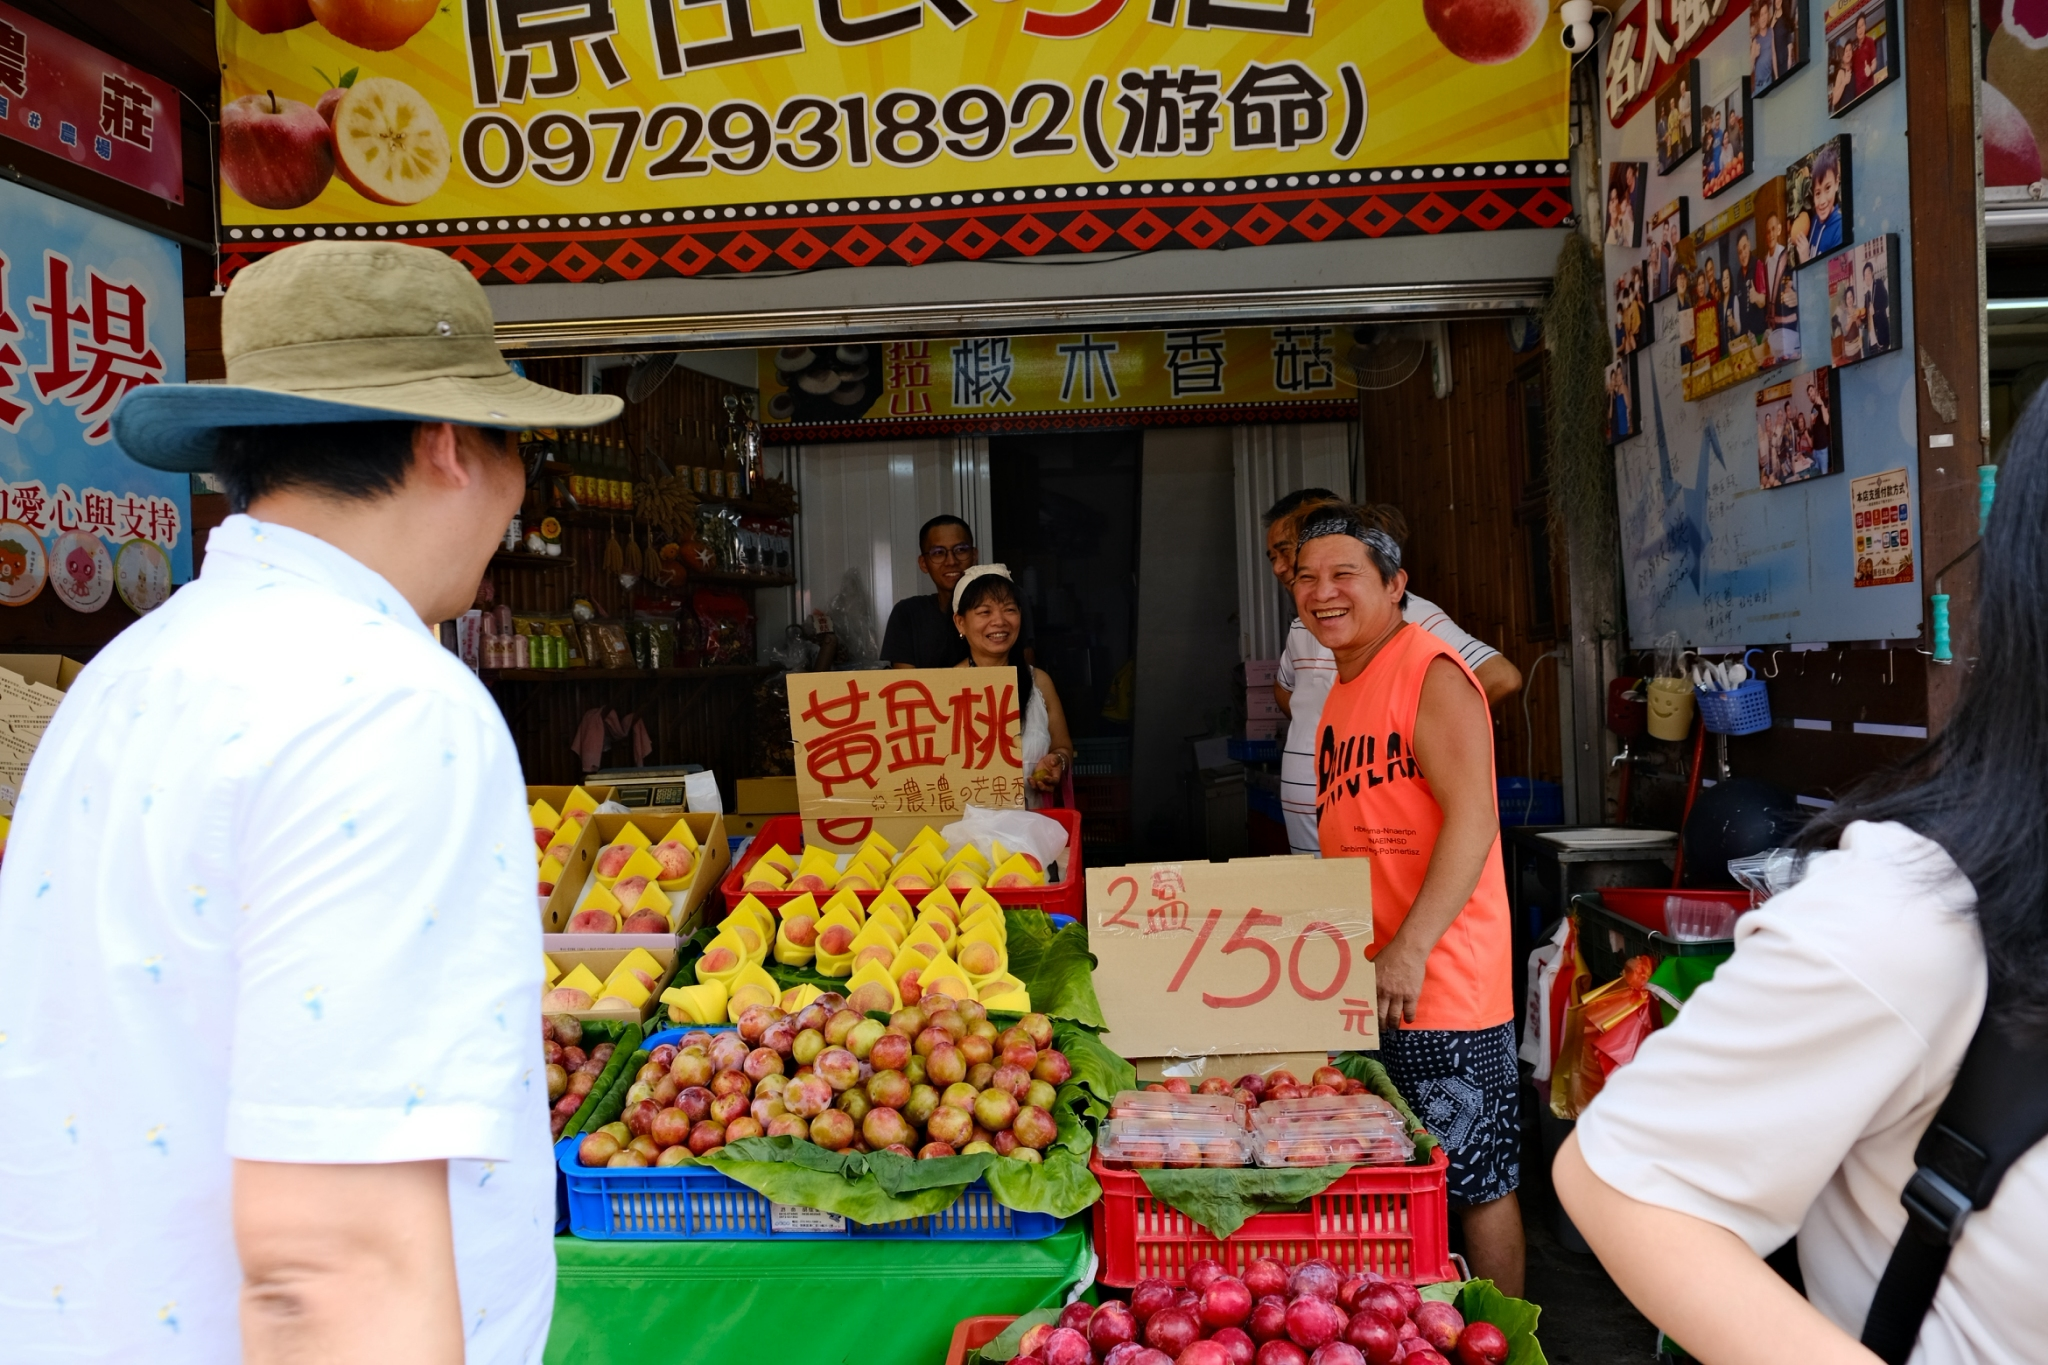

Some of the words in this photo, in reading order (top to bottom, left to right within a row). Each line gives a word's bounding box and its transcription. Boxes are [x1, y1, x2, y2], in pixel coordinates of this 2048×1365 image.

[1605, 0, 1728, 120] 名人強
[461, 59, 1368, 188] 0972931892(游命)
[0, 254, 164, 438] 場
[0, 486, 177, 542] 愛心與支持
[801, 679, 1023, 798] 黃金桃
